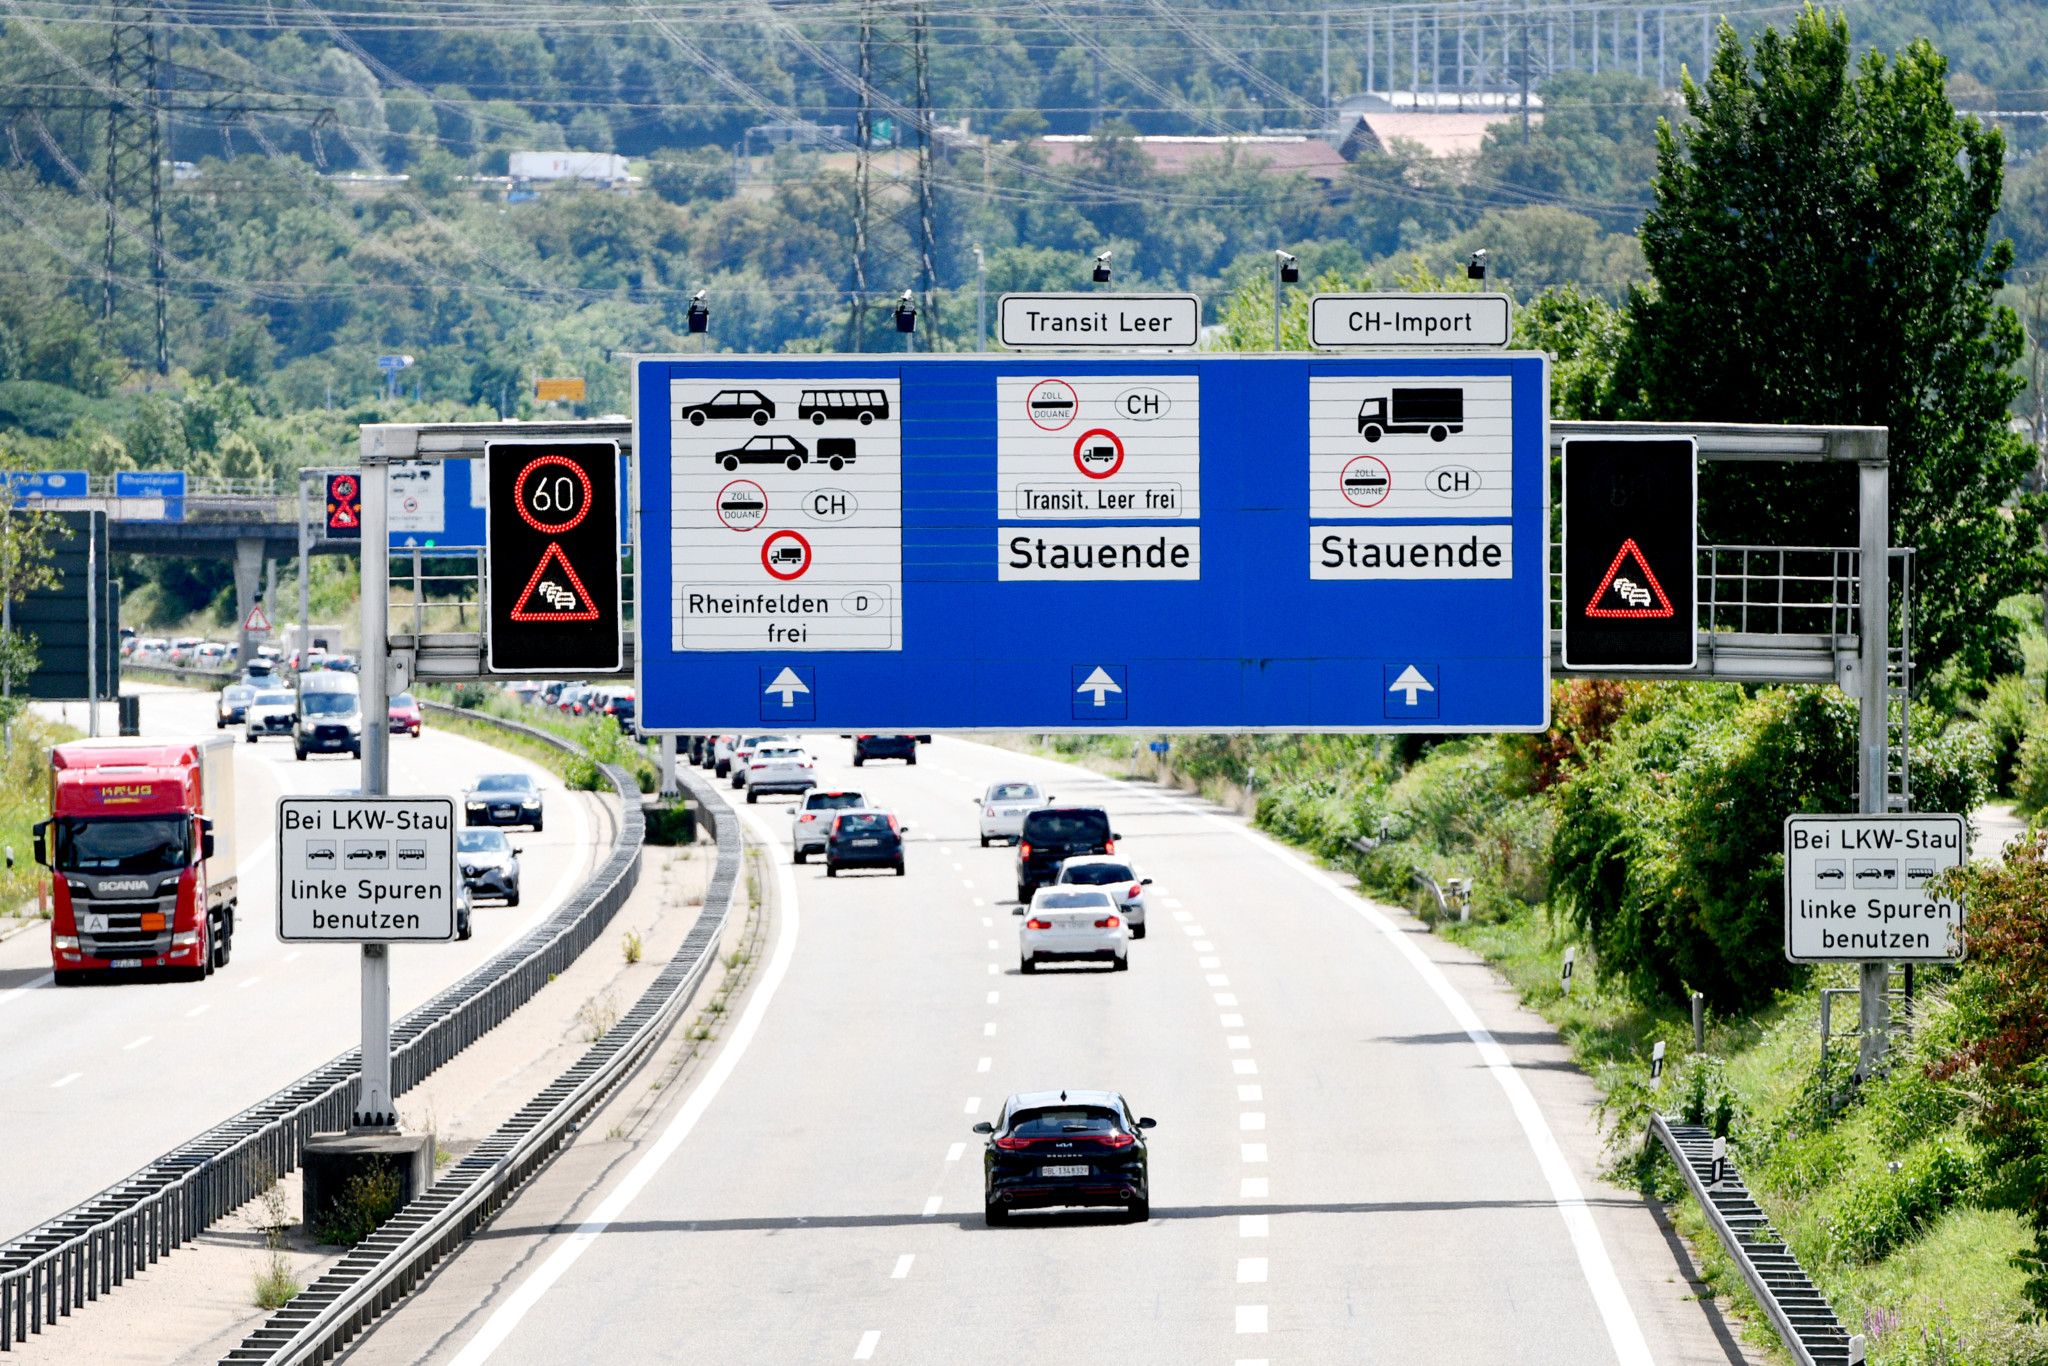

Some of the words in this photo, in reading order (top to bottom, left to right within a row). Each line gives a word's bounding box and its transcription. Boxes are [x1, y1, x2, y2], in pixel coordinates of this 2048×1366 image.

[1026, 311, 1108, 332] Transit
[1120, 312, 1173, 332] Leer
[1348, 311, 1472, 336] CH-Import
[1041, 391, 1063, 400] ZOLL
[1127, 394, 1159, 415] CH
[1034, 410, 1070, 418] DOUANE
[1354, 469, 1376, 478] ZOLL
[1437, 472, 1470, 492] CH
[532, 476, 574, 512] 60
[731, 492, 753, 501] ZOLL
[1024, 489, 1089, 510] Transit.
[1098, 489, 1135, 509] Leer
[1146, 489, 1175, 509] frei
[1347, 487, 1384, 496] DOUANE
[814, 495, 846, 515] CH
[724, 511, 761, 520] DOUANE
[1009, 536, 1189, 569] Stauende
[1321, 535, 1502, 568] Stauende
[689, 594, 829, 614] Rheinfelden
[856, 597, 868, 611] D
[768, 624, 807, 643] frei
[102, 785, 152, 797] KRUG
[286, 809, 322, 830] Bei
[333, 810, 448, 830] LKW-Stau
[1794, 829, 1830, 849] Bei
[1841, 829, 1957, 849] LKW-Stau
[98, 880, 149, 891] SCANIA
[291, 879, 347, 899] linke
[358, 879, 442, 904] Spuren
[313, 909, 420, 929] benutzen
[1801, 899, 1857, 919] linke
[1867, 898, 1952, 924] Spuren
[90, 916, 103, 930] A
[1822, 928, 1930, 949] benutzen
